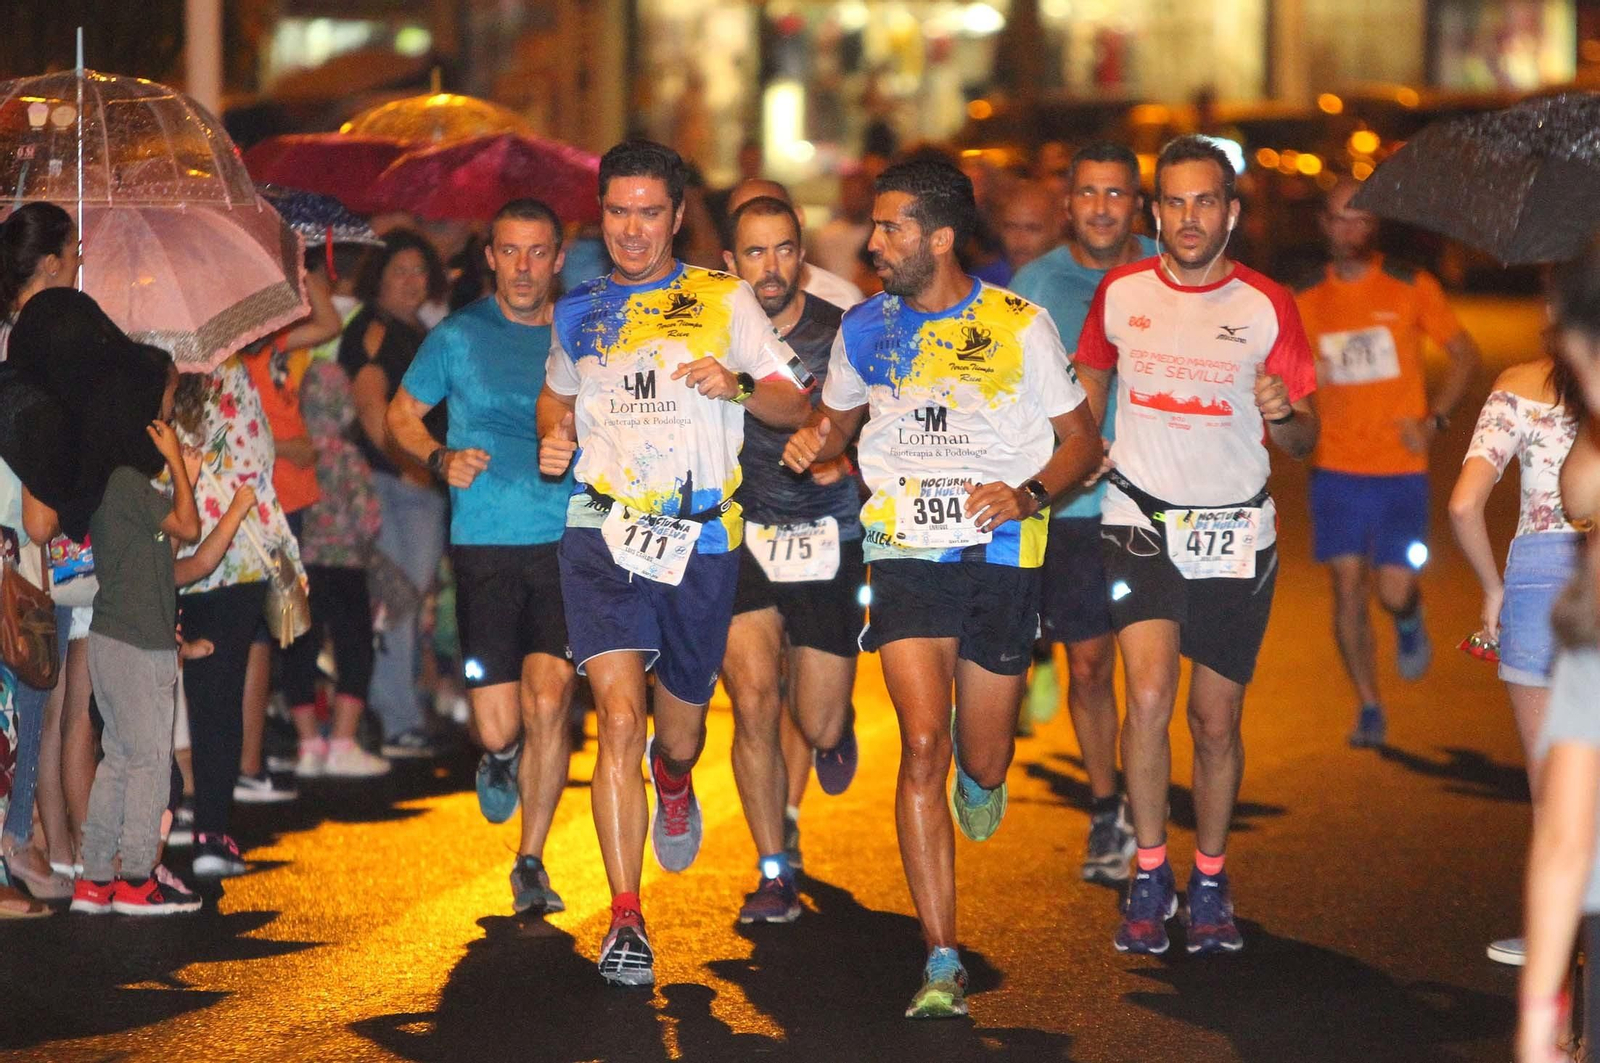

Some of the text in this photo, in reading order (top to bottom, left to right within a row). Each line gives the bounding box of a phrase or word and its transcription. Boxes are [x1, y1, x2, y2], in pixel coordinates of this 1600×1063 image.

[1150, 352, 1186, 365] MEDIO
[1133, 360, 1235, 385] DE SEVILLA
[610, 399, 677, 414] Lorman
[899, 428, 970, 445] Lorman
[935, 449, 942, 457] &
[920, 486, 967, 497] DE HUELV
[913, 496, 963, 525] 394
[623, 525, 668, 560] 111
[766, 537, 812, 562] 775
[1186, 530, 1234, 556] 472
